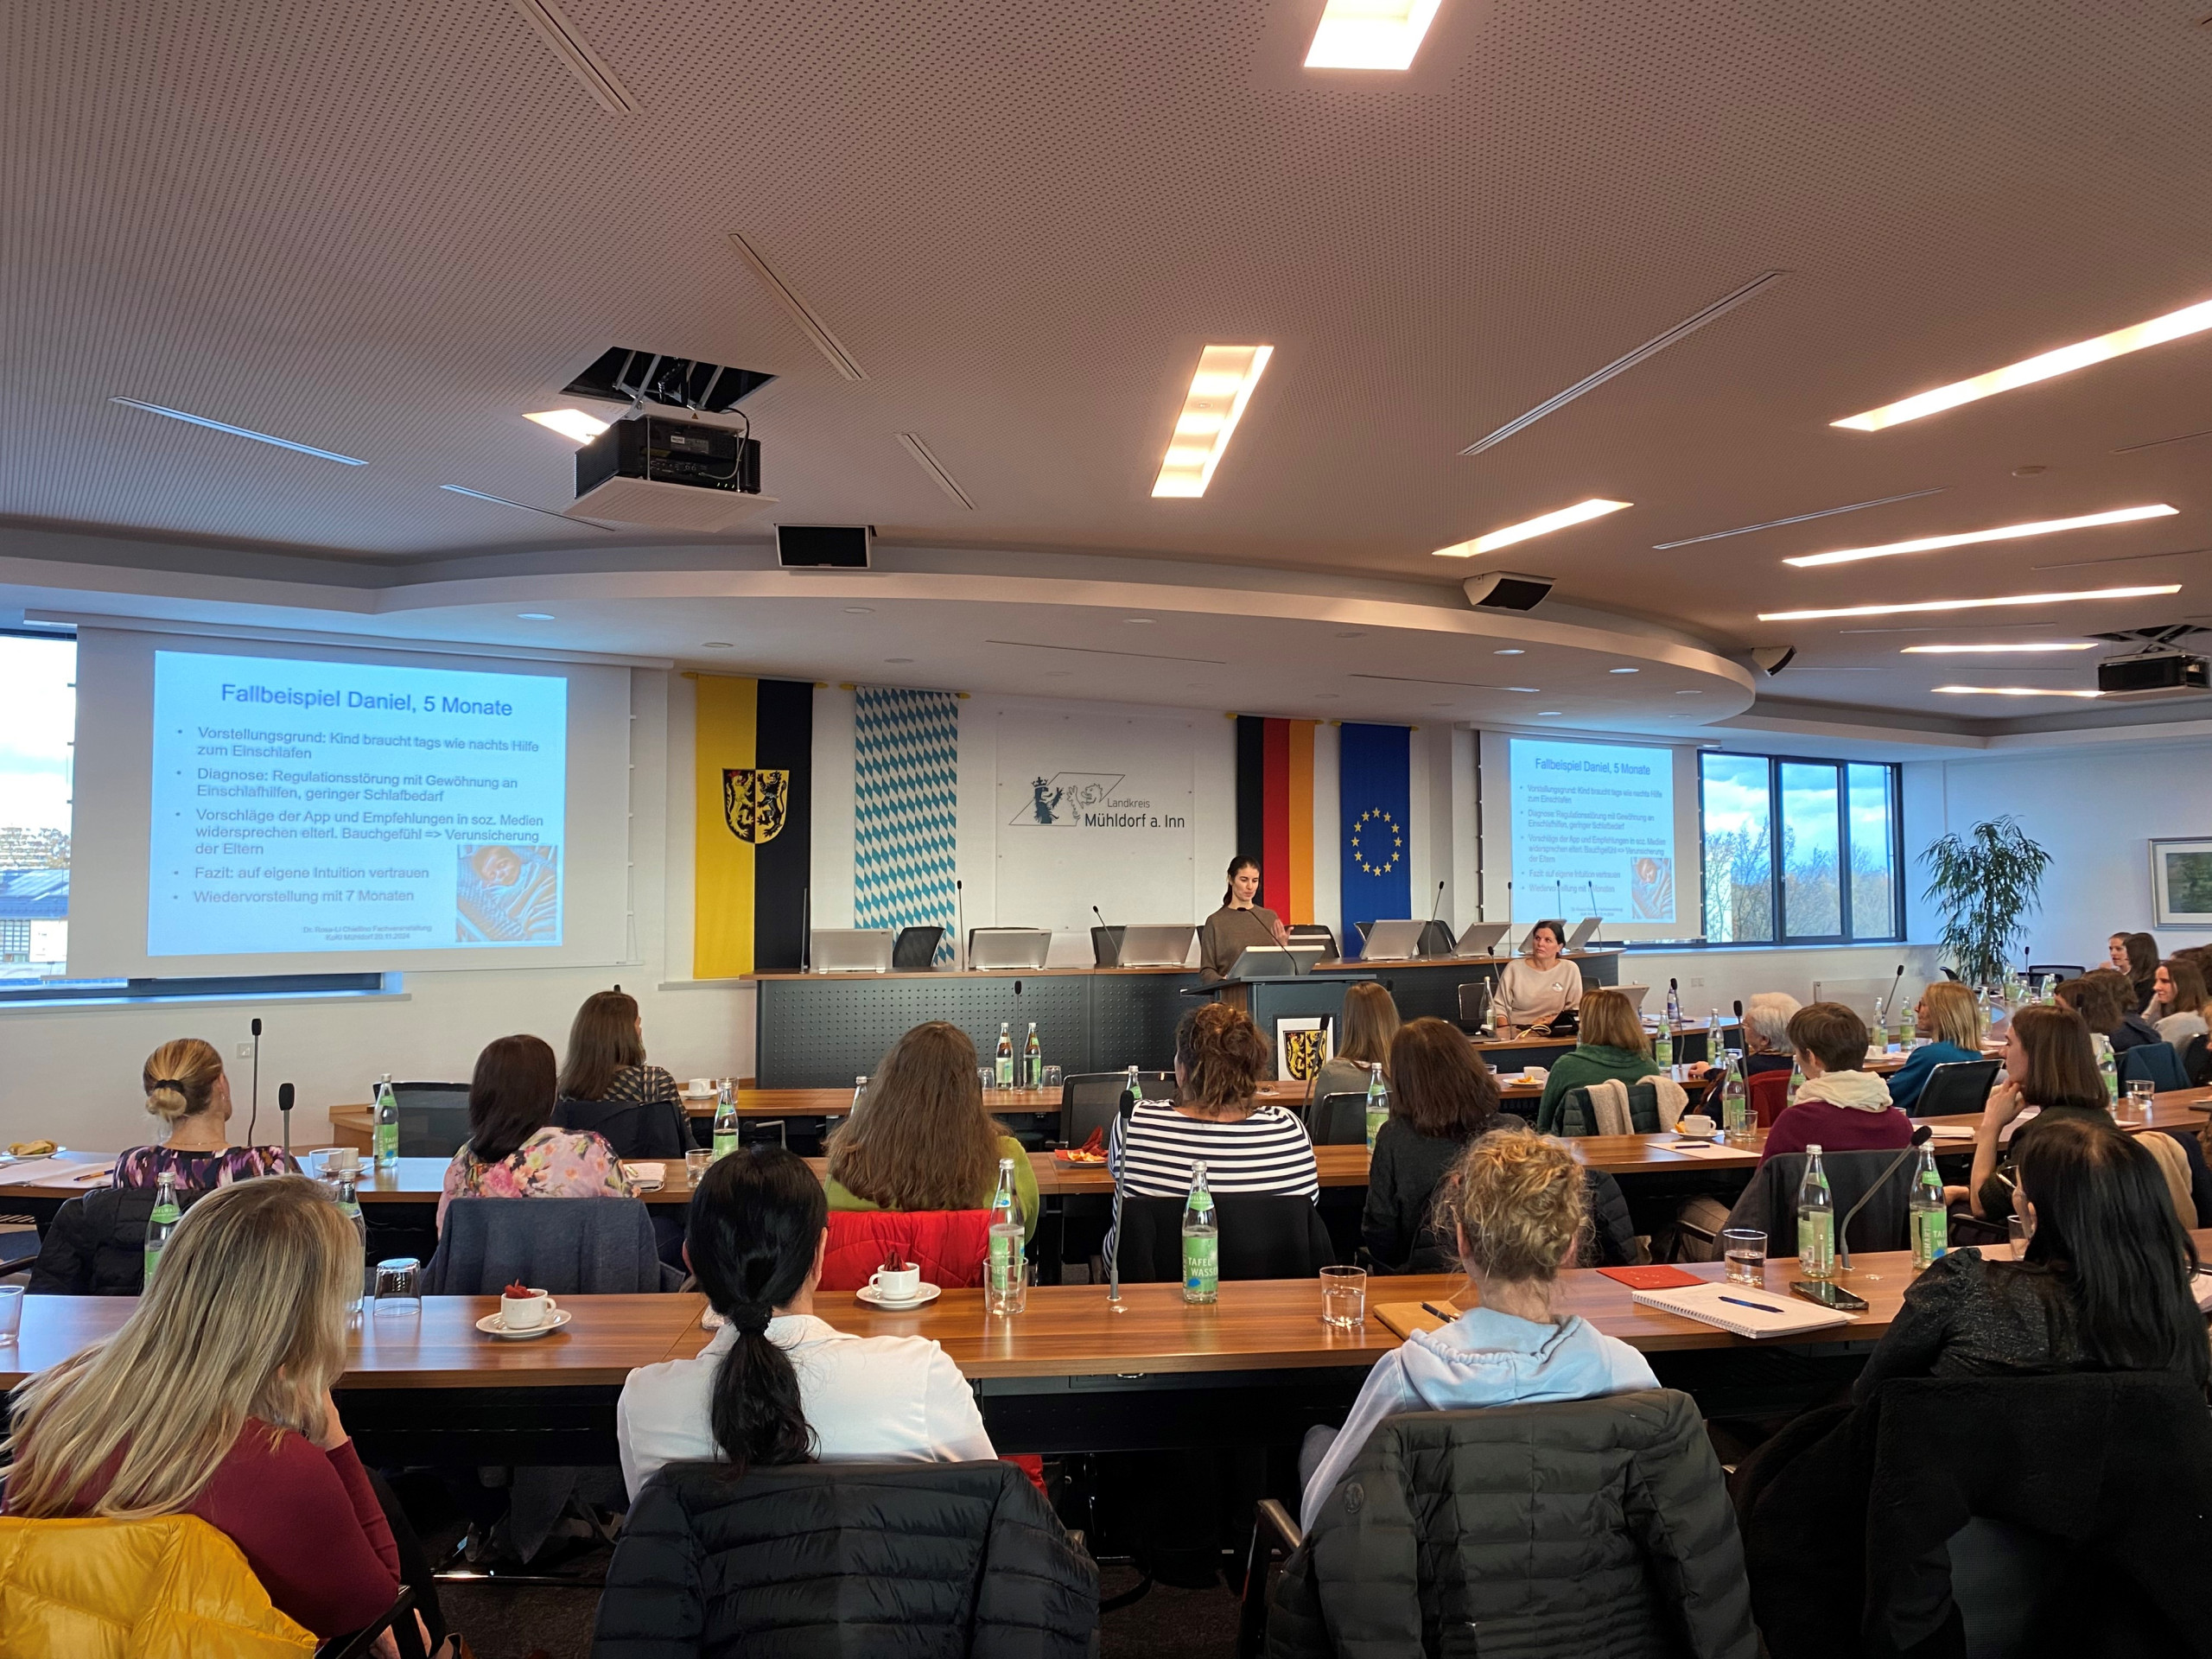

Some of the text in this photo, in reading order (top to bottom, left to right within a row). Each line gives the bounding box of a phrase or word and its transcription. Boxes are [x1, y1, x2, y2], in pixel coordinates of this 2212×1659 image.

[222, 683, 512, 716] Fallbeispiel Daniel, 5 Monate
[198, 727, 539, 753] Vorstellungsgrund: Kind braucht tags wie nachts Hilfe
[197, 745, 312, 759] zum Einschlafen
[1535, 758, 1650, 775] Fallbeispiel Daniel, 5 Monate
[198, 768, 518, 790] Diagnose: Regulationsstörung mit Gewöhnung an
[197, 785, 444, 802] Einschlafhilfen, geringer Schlafbedarf
[1107, 798, 1150, 809] Landkreis
[196, 809, 543, 826] Vorschläge der App und Empfehlungen in soz. Medien
[1084, 813, 1185, 828] Mühldorf a. Inn
[196, 826, 297, 840] widersprechen
[302, 828, 338, 839] elterl.
[342, 828, 422, 842] Bauchgefühl
[445, 830, 539, 843] Verunsicherung
[195, 843, 264, 855] der Eltern
[195, 867, 429, 880] Fazit: auf eigene Intuition vertrauen
[194, 890, 414, 904] Wiedervorstellung mit 7 Monaten
[1187, 1256, 1211, 1267] TAFEL
[1191, 1267, 1217, 1276] WASSE
